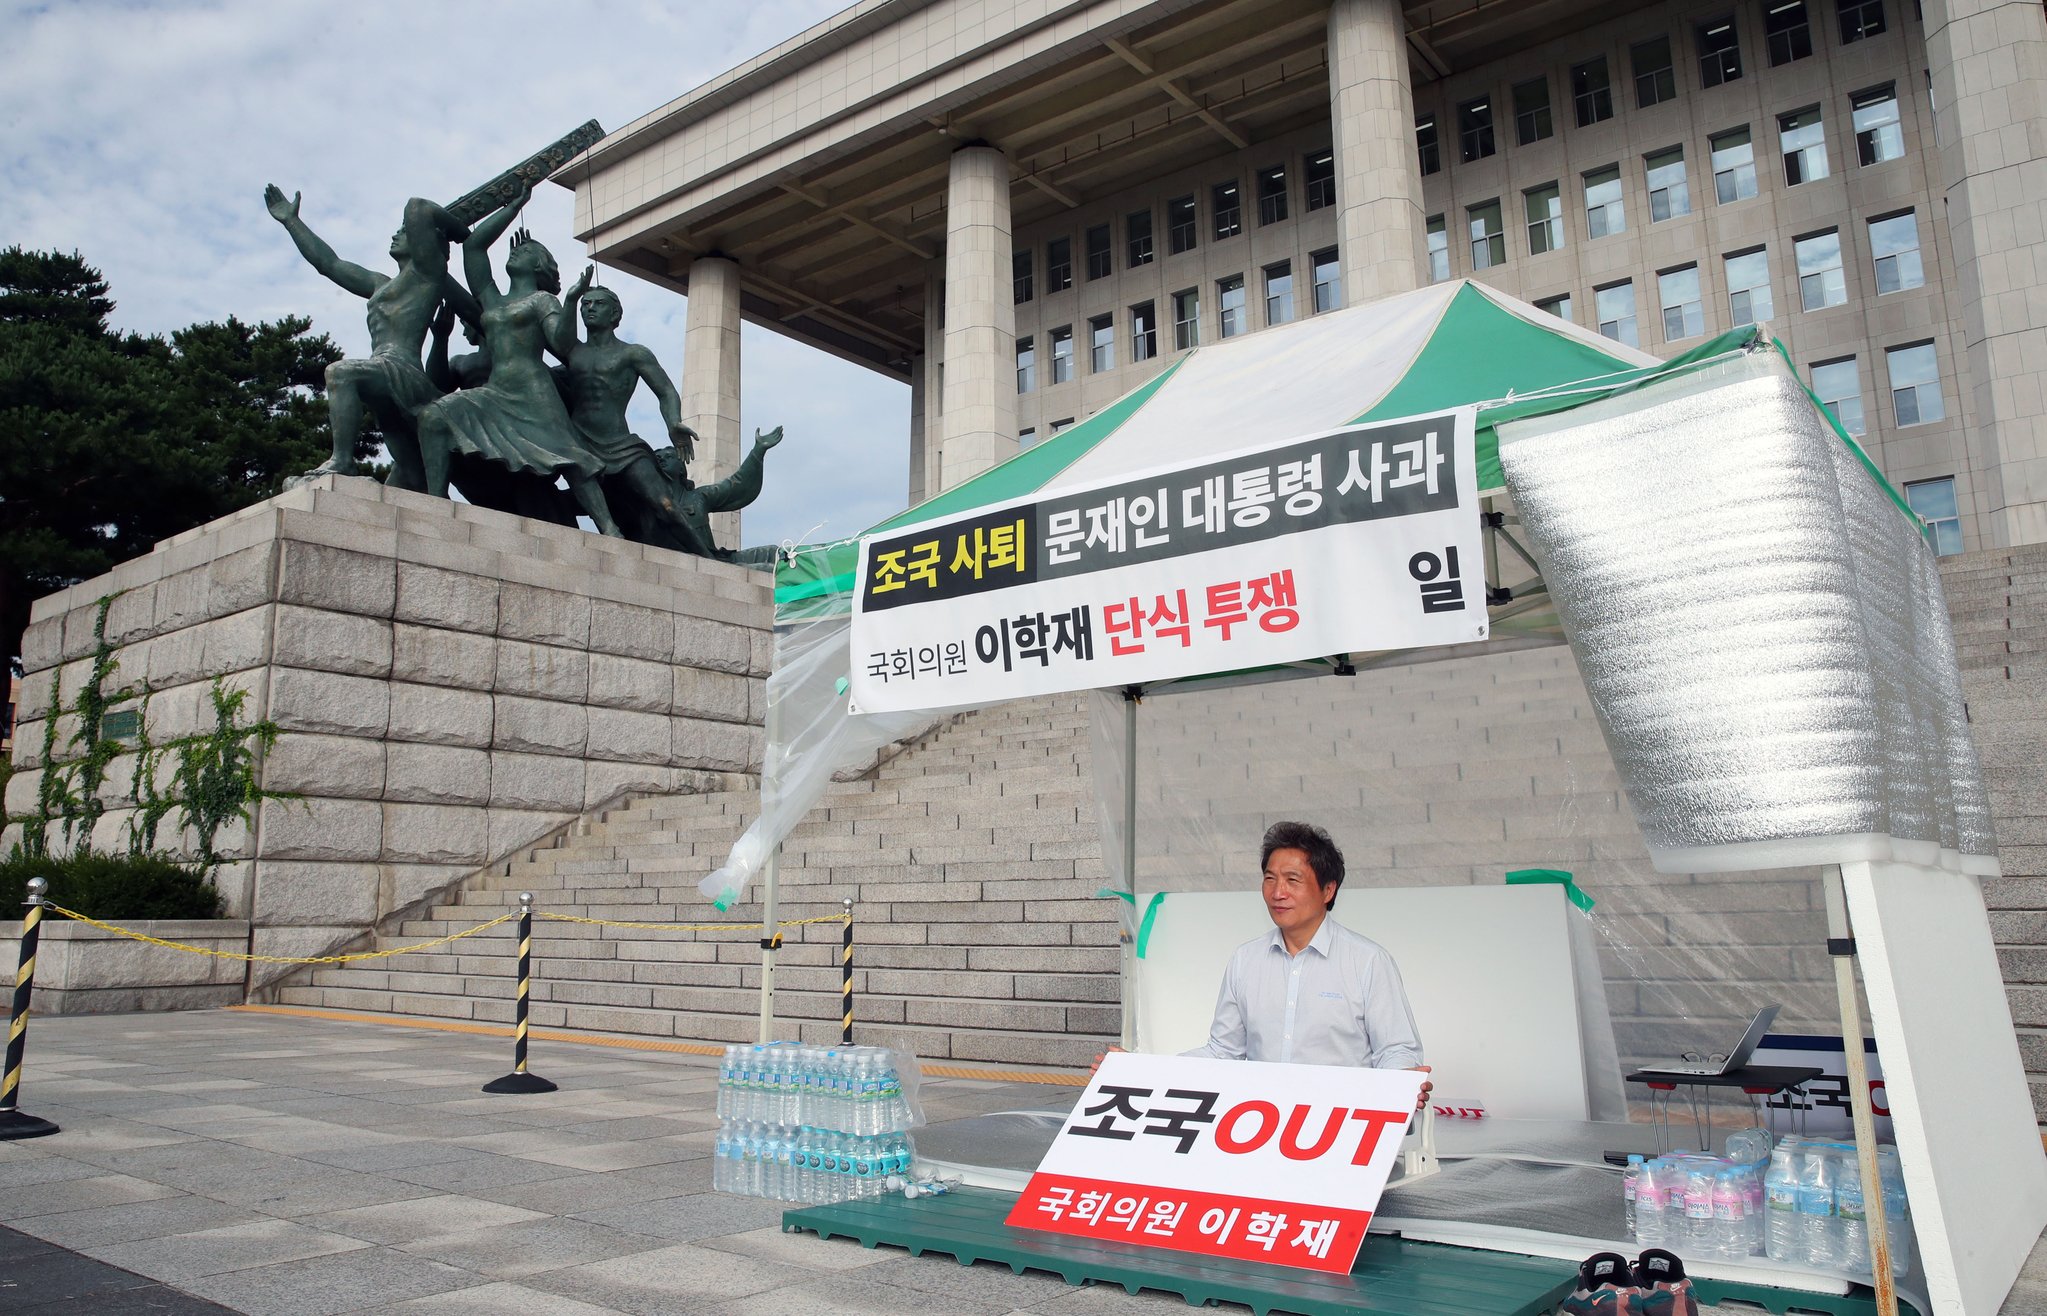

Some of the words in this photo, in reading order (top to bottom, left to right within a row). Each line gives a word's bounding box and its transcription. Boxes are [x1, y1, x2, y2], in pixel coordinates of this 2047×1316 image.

[872, 541, 941, 595] 조국
[949, 518, 1026, 580] 사퇴
[1045, 487, 1170, 565] 문재인
[1182, 452, 1323, 532] 대통령
[1336, 431, 1446, 503] 사과
[866, 639, 969, 684] 국회의원
[975, 604, 1094, 673] 이학재
[1103, 588, 1192, 657] 단식
[1203, 569, 1300, 641] 투쟁
[1408, 545, 1466, 614] 일
[1037, 1186, 1188, 1238] 국회의원
[1198, 1207, 1341, 1260] 이학재
